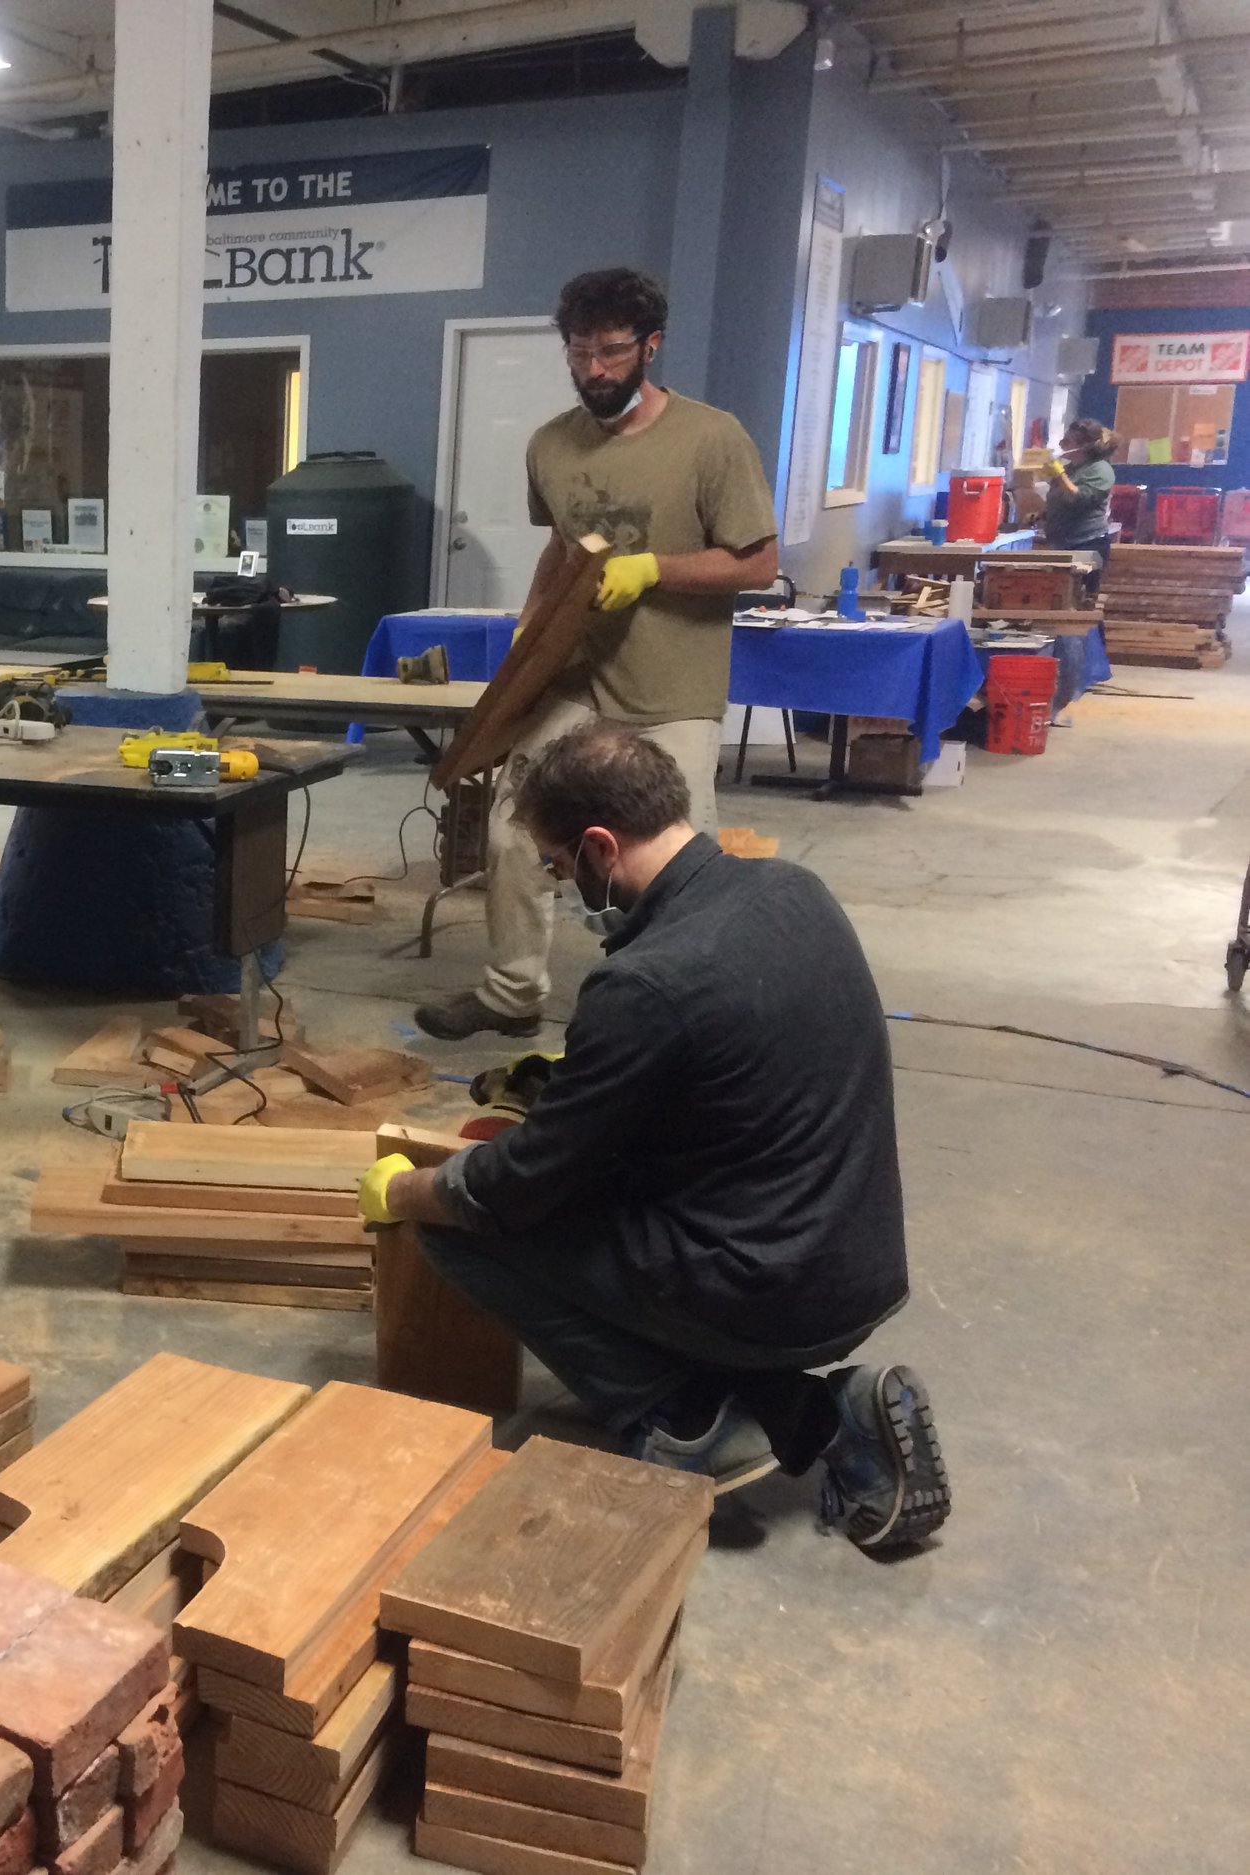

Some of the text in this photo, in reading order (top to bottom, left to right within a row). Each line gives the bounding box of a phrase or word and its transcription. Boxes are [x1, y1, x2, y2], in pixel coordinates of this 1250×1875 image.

[251, 177, 288, 203] TO
[298, 171, 353, 200] THE
[206, 226, 339, 246] baltimore community
[1158, 343, 1205, 355] TEAM
[1155, 359, 1203, 372] DEPOT
